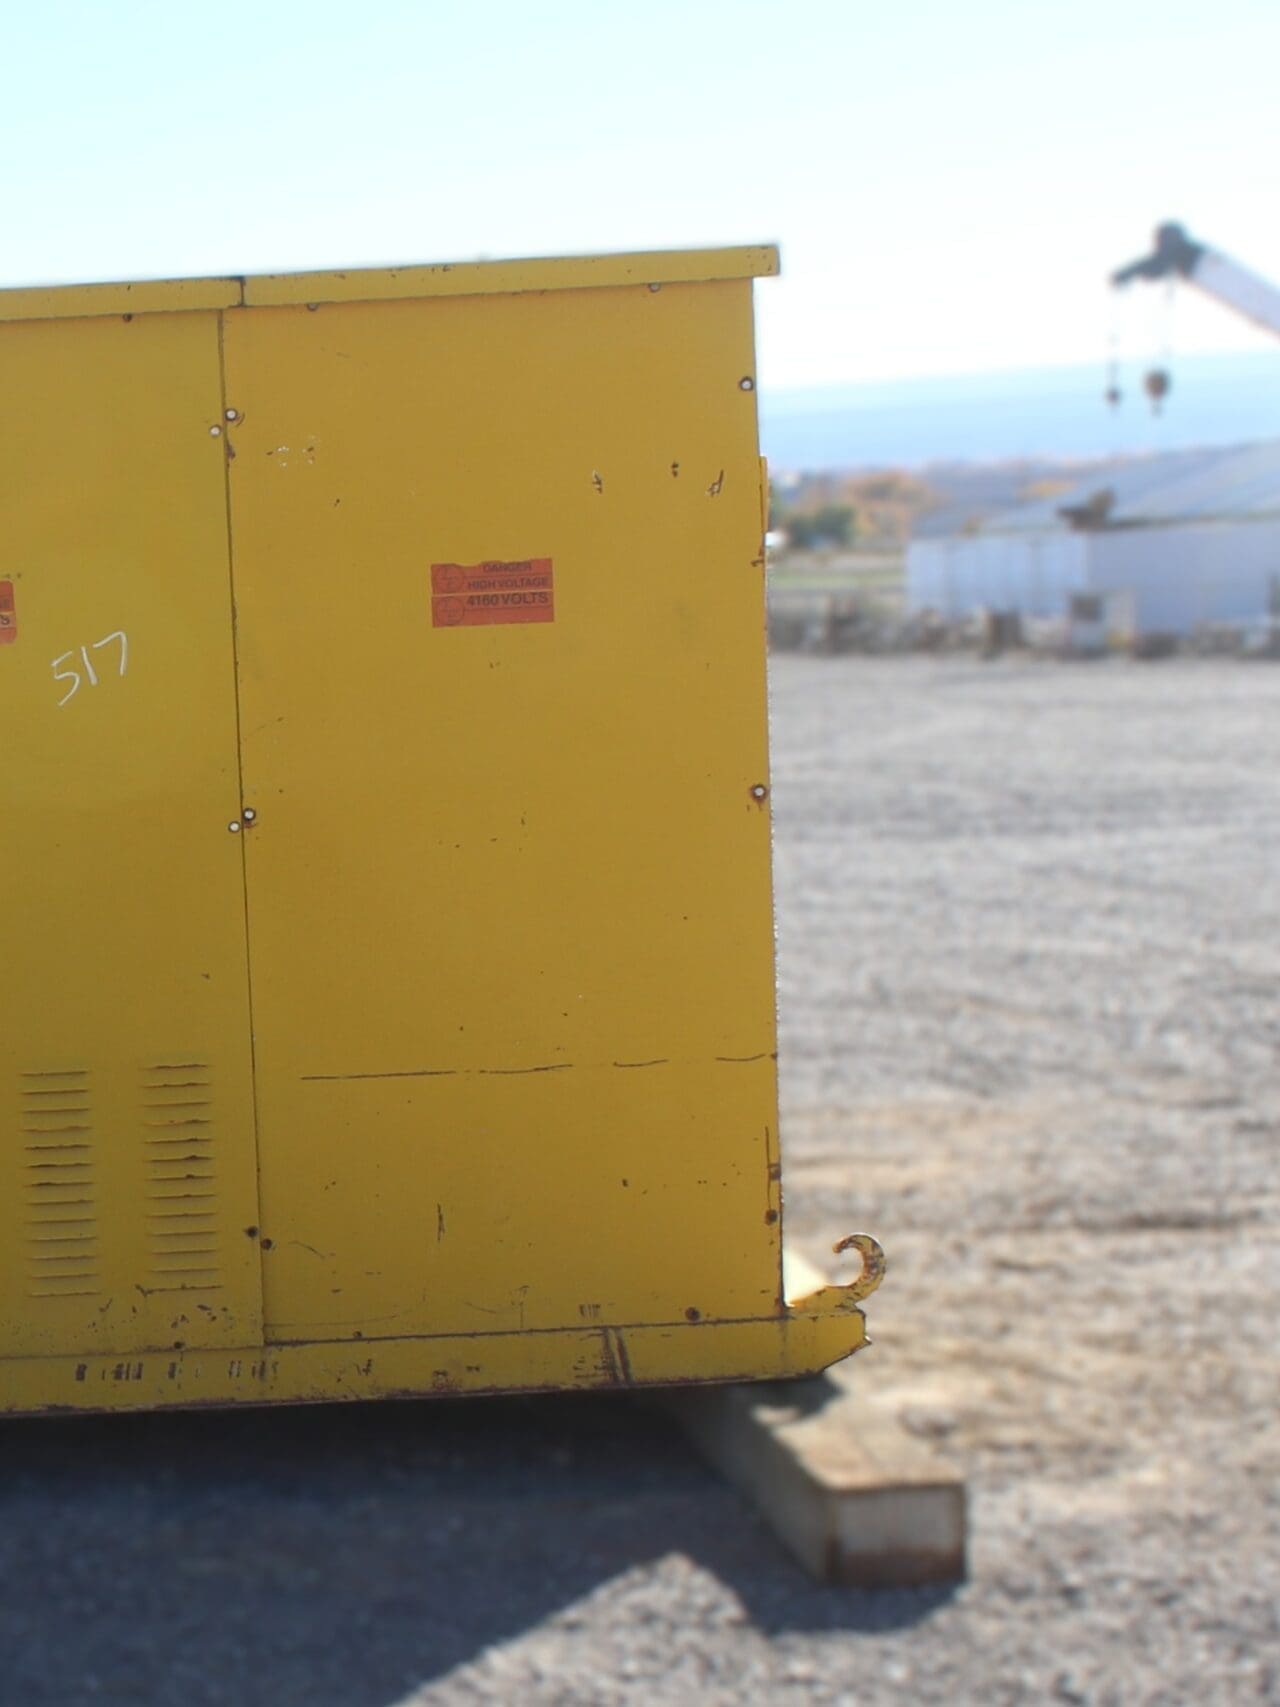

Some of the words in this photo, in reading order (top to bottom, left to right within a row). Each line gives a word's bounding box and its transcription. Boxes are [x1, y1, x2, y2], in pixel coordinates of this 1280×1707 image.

[468, 579, 496, 590] HIGH
[497, 576, 548, 589] VOLTAGE
[466, 594, 499, 606] 4160
[501, 592, 549, 605] VOLTS
[50, 630, 128, 706] 517
